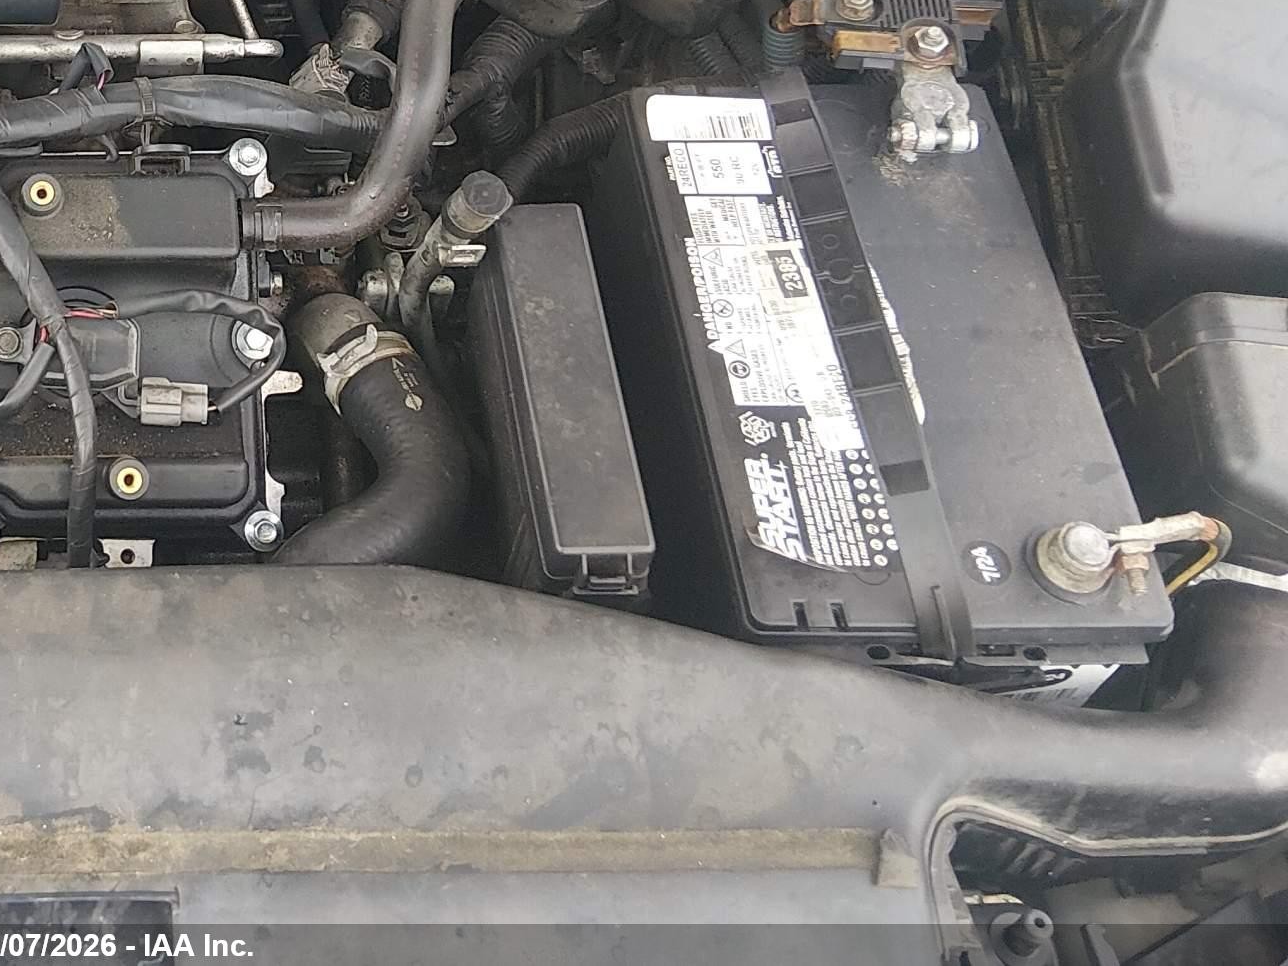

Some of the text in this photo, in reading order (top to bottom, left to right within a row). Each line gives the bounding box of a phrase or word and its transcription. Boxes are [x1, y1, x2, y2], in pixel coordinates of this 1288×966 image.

[709, 159, 725, 179] 550
[683, 237, 719, 339] DANGER/POISON
[775, 256, 804, 291] 2385
[744, 458, 777, 548] SUPER
[763, 459, 806, 560] START
